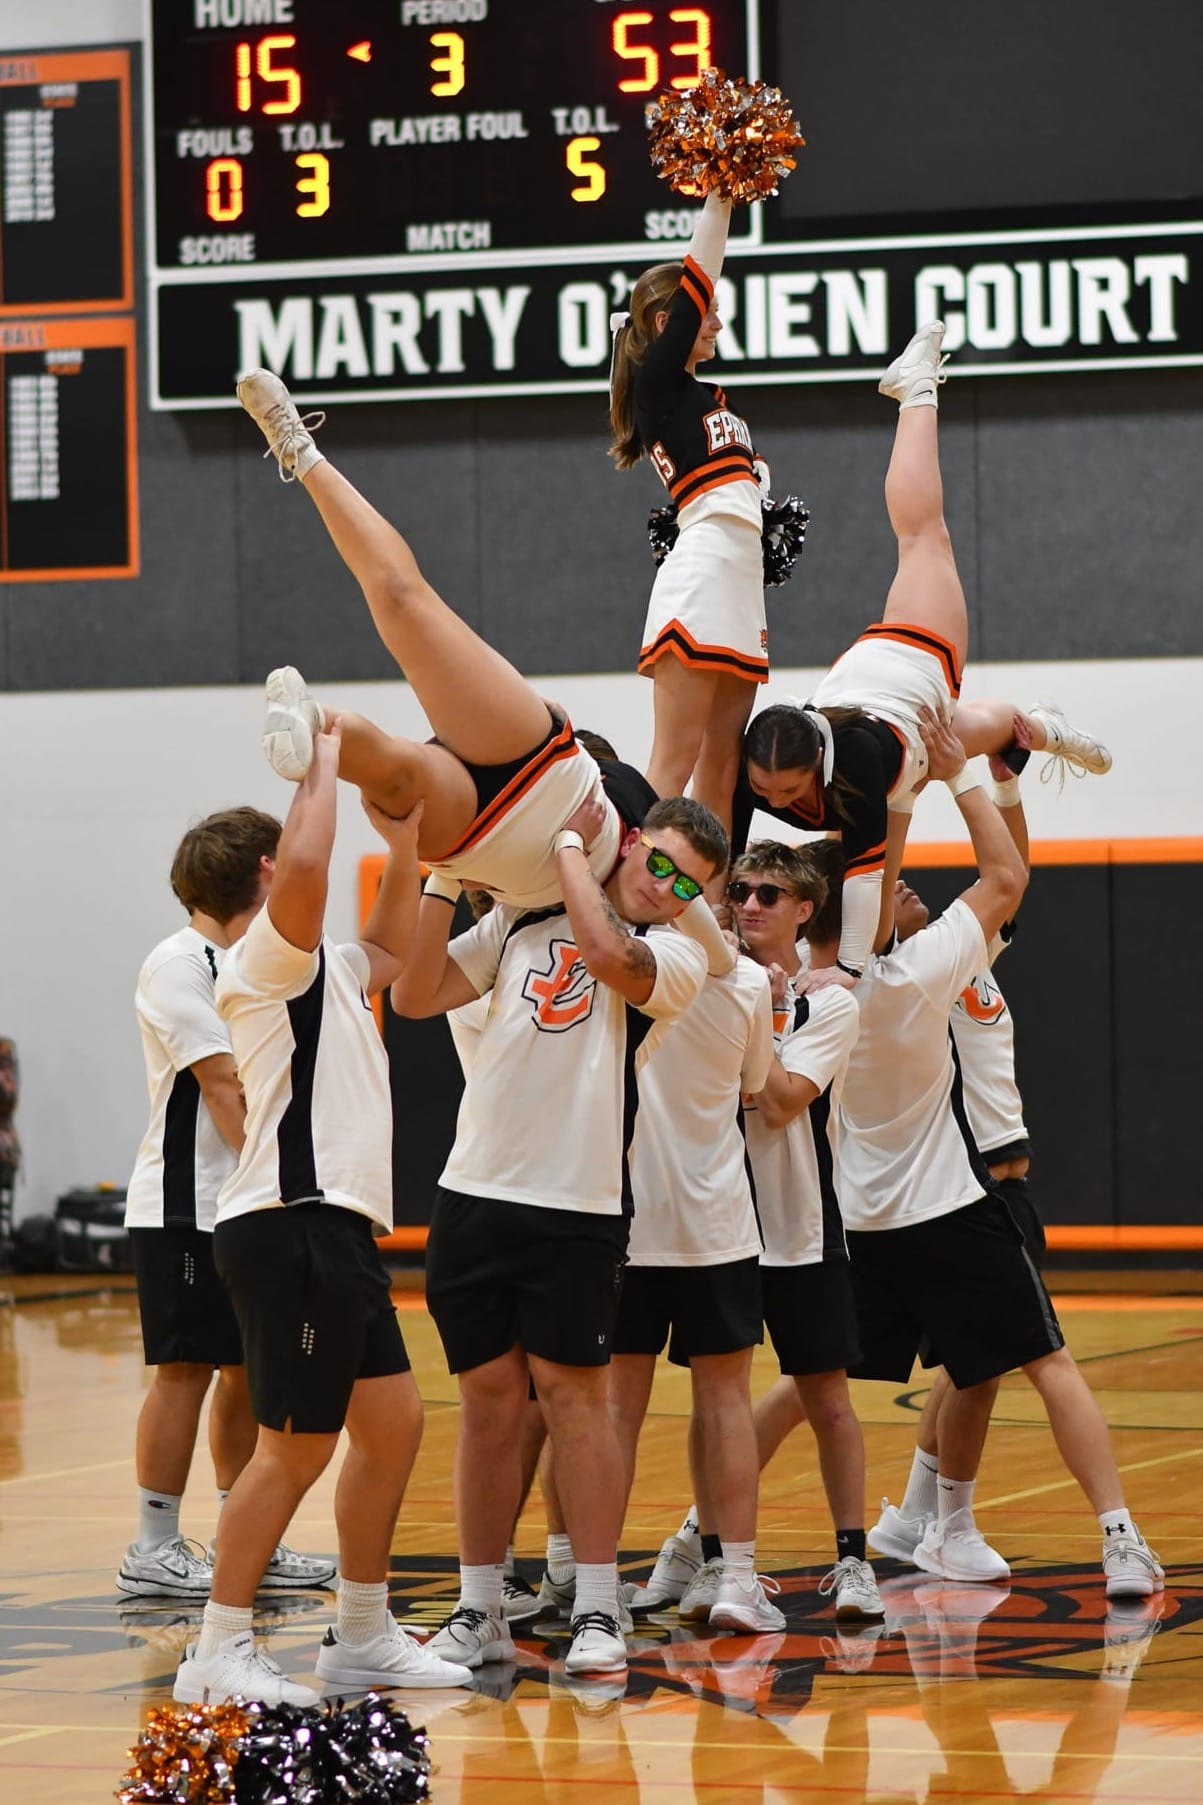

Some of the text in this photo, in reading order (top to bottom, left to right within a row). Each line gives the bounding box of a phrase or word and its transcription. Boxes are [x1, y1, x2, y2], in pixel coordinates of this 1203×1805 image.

[195, 0, 294, 28] HOME
[402, 0, 487, 26] PERIOD
[430, 32, 465, 97] 3
[613, 8, 711, 94] 53
[235, 35, 302, 115] 15
[278, 123, 344, 151] T.O.L.
[370, 112, 529, 147] PLAYER FOUL
[553, 108, 619, 135] T.O.L.
[177, 127, 253, 158] FOULS
[295, 152, 330, 218] 3
[566, 136, 606, 203] 5
[206, 158, 243, 222] 0
[407, 222, 491, 252] MATCH
[645, 208, 706, 239] SCO
[180, 234, 256, 265] SCORE
[234, 252, 1190, 382] MARTY O'RIEN COURT
